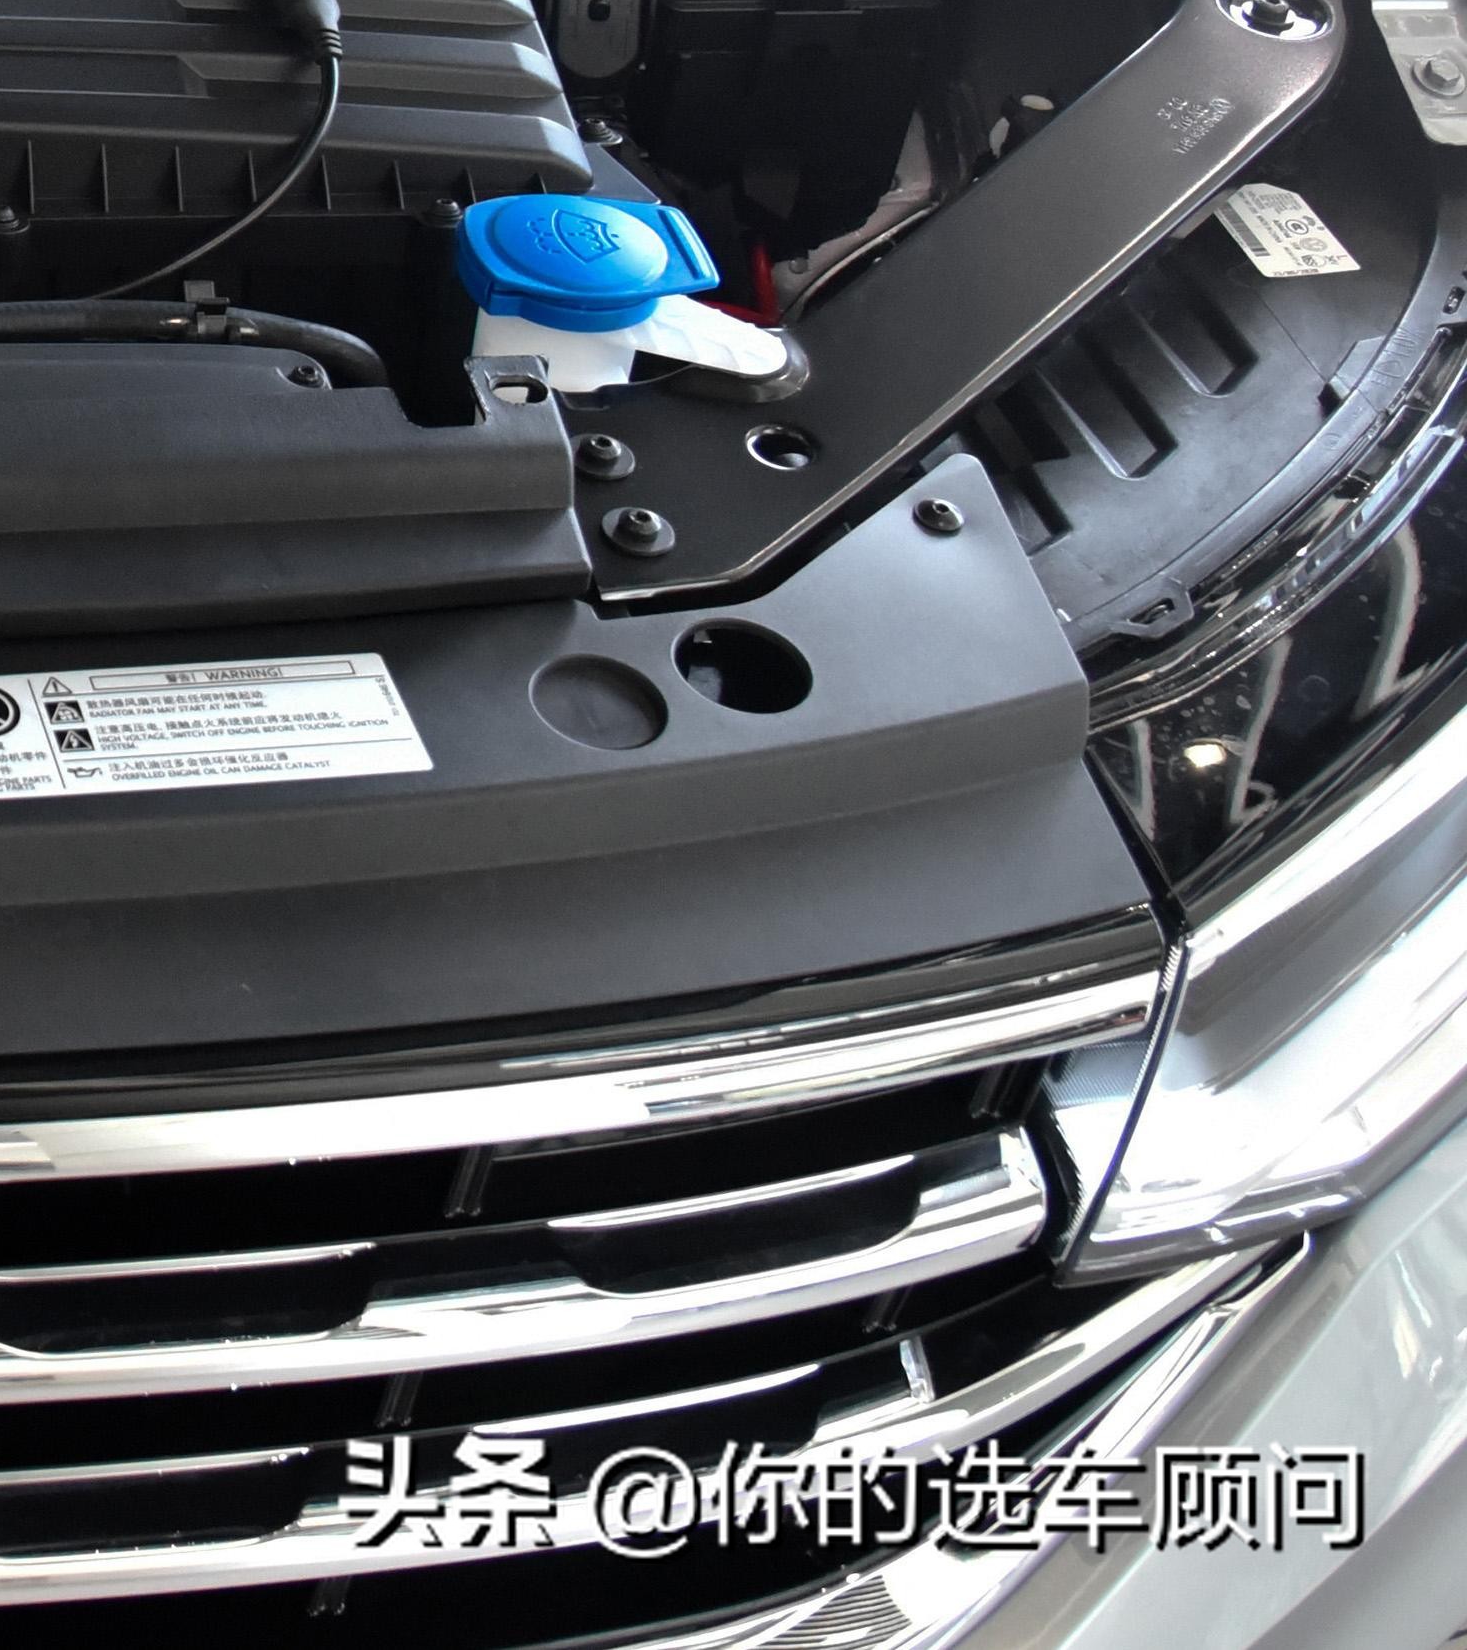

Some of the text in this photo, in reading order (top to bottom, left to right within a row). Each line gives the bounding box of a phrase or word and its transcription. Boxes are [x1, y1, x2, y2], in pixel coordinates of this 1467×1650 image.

[205, 667, 285, 682] WARNING!
[90, 707, 134, 718] RADIATOR
[136, 706, 155, 715] FAN
[157, 705, 177, 714] MAY
[179, 703, 208, 712] START
[209, 703, 222, 711] AT
[223, 702, 242, 710] ANY
[98, 733, 122, 743] HIGH
[172, 730, 205, 739] SWITCH
[208, 728, 224, 737] OFF
[227, 726, 261, 736] ENGINE
[263, 724, 296, 733] BEFORE
[298, 721, 346, 731] TOUCHING
[348, 718, 389, 728] IGNITION
[111, 760, 330, 781] OVERFILLED ENGINE OIL CAN DAMAGE CATALYST
[21, 774, 52, 784] PARTS
[6, 782, 36, 792] PARTS
